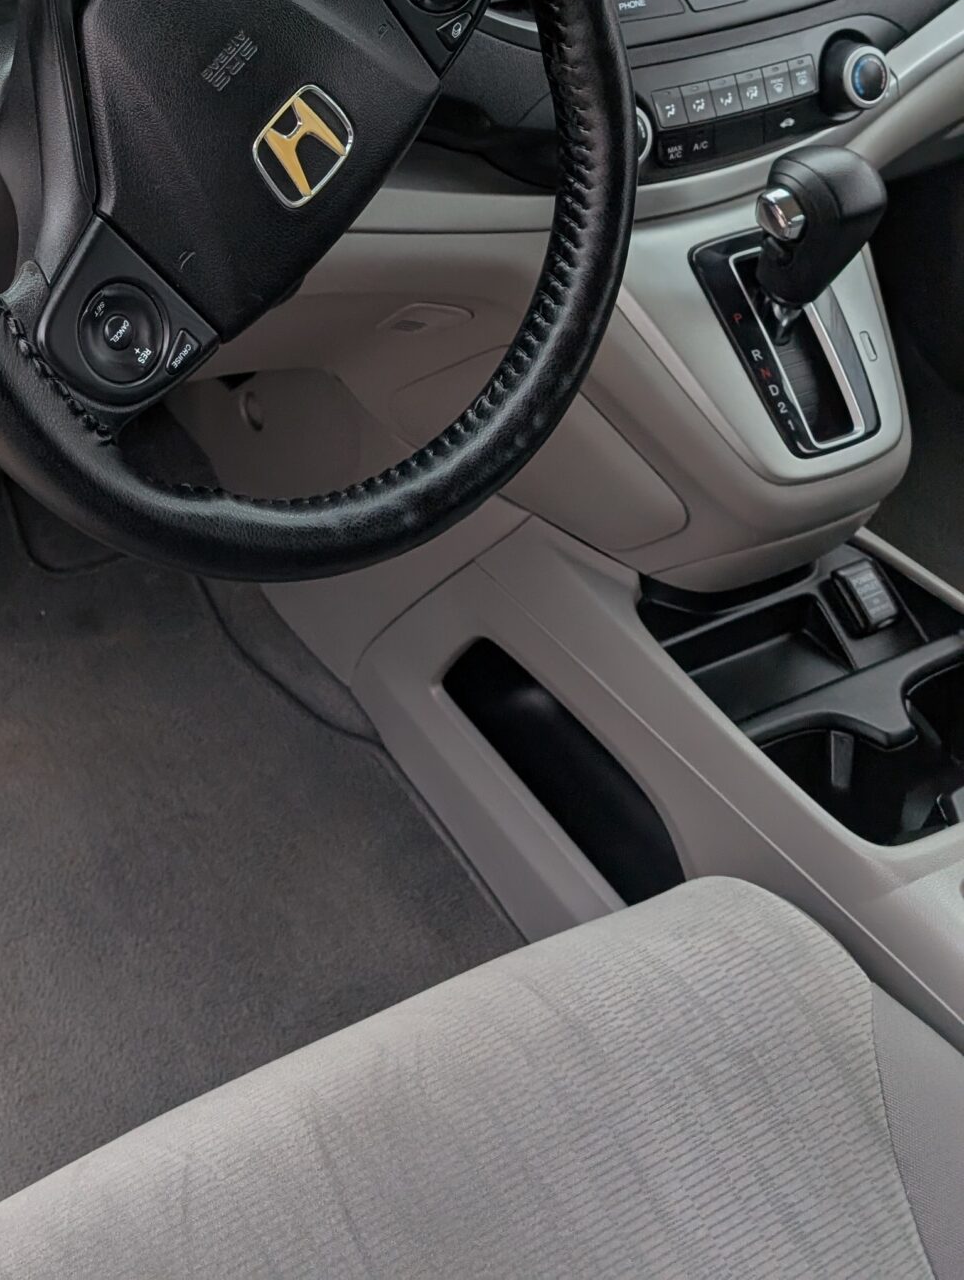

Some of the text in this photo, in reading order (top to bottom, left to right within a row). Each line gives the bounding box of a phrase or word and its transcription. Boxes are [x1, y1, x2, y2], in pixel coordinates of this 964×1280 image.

[212, 37, 258, 92] SRS
[667, 144, 683, 154] MAX
[692, 140, 709, 152] A/C
[669, 151, 683, 161] A/C
[94, 301, 105, 318] SET
[109, 319, 130, 343] CANCEL
[137, 347, 152, 364] RES
[171, 343, 192, 369] CRUISE
[750, 349, 763, 362] R
[768, 384, 780, 396] D
[777, 401, 788, 414] 2
[787, 420, 795, 431] 1
